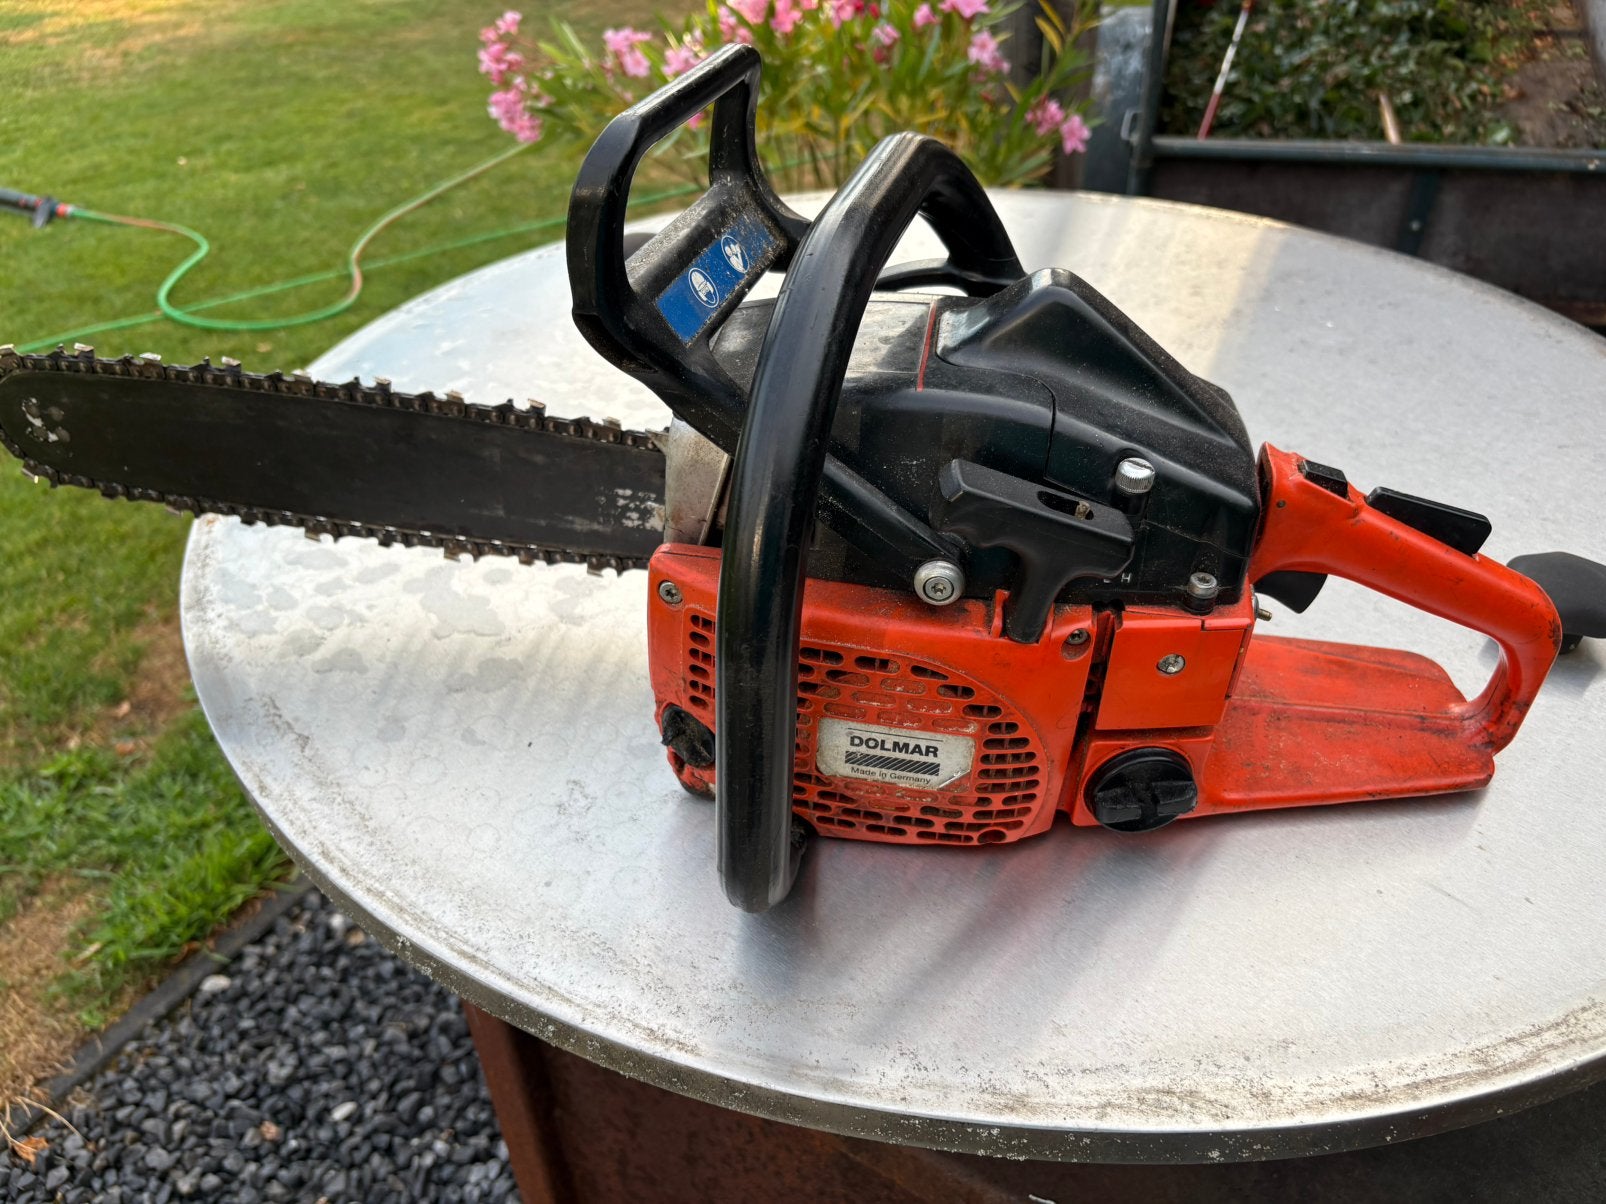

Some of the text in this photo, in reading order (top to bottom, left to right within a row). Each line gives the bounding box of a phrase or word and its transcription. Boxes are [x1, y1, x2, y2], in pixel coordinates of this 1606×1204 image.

[850, 735, 939, 758] DOLMAR
[850, 766, 877, 777] Made
[889, 772, 931, 785] Germany
